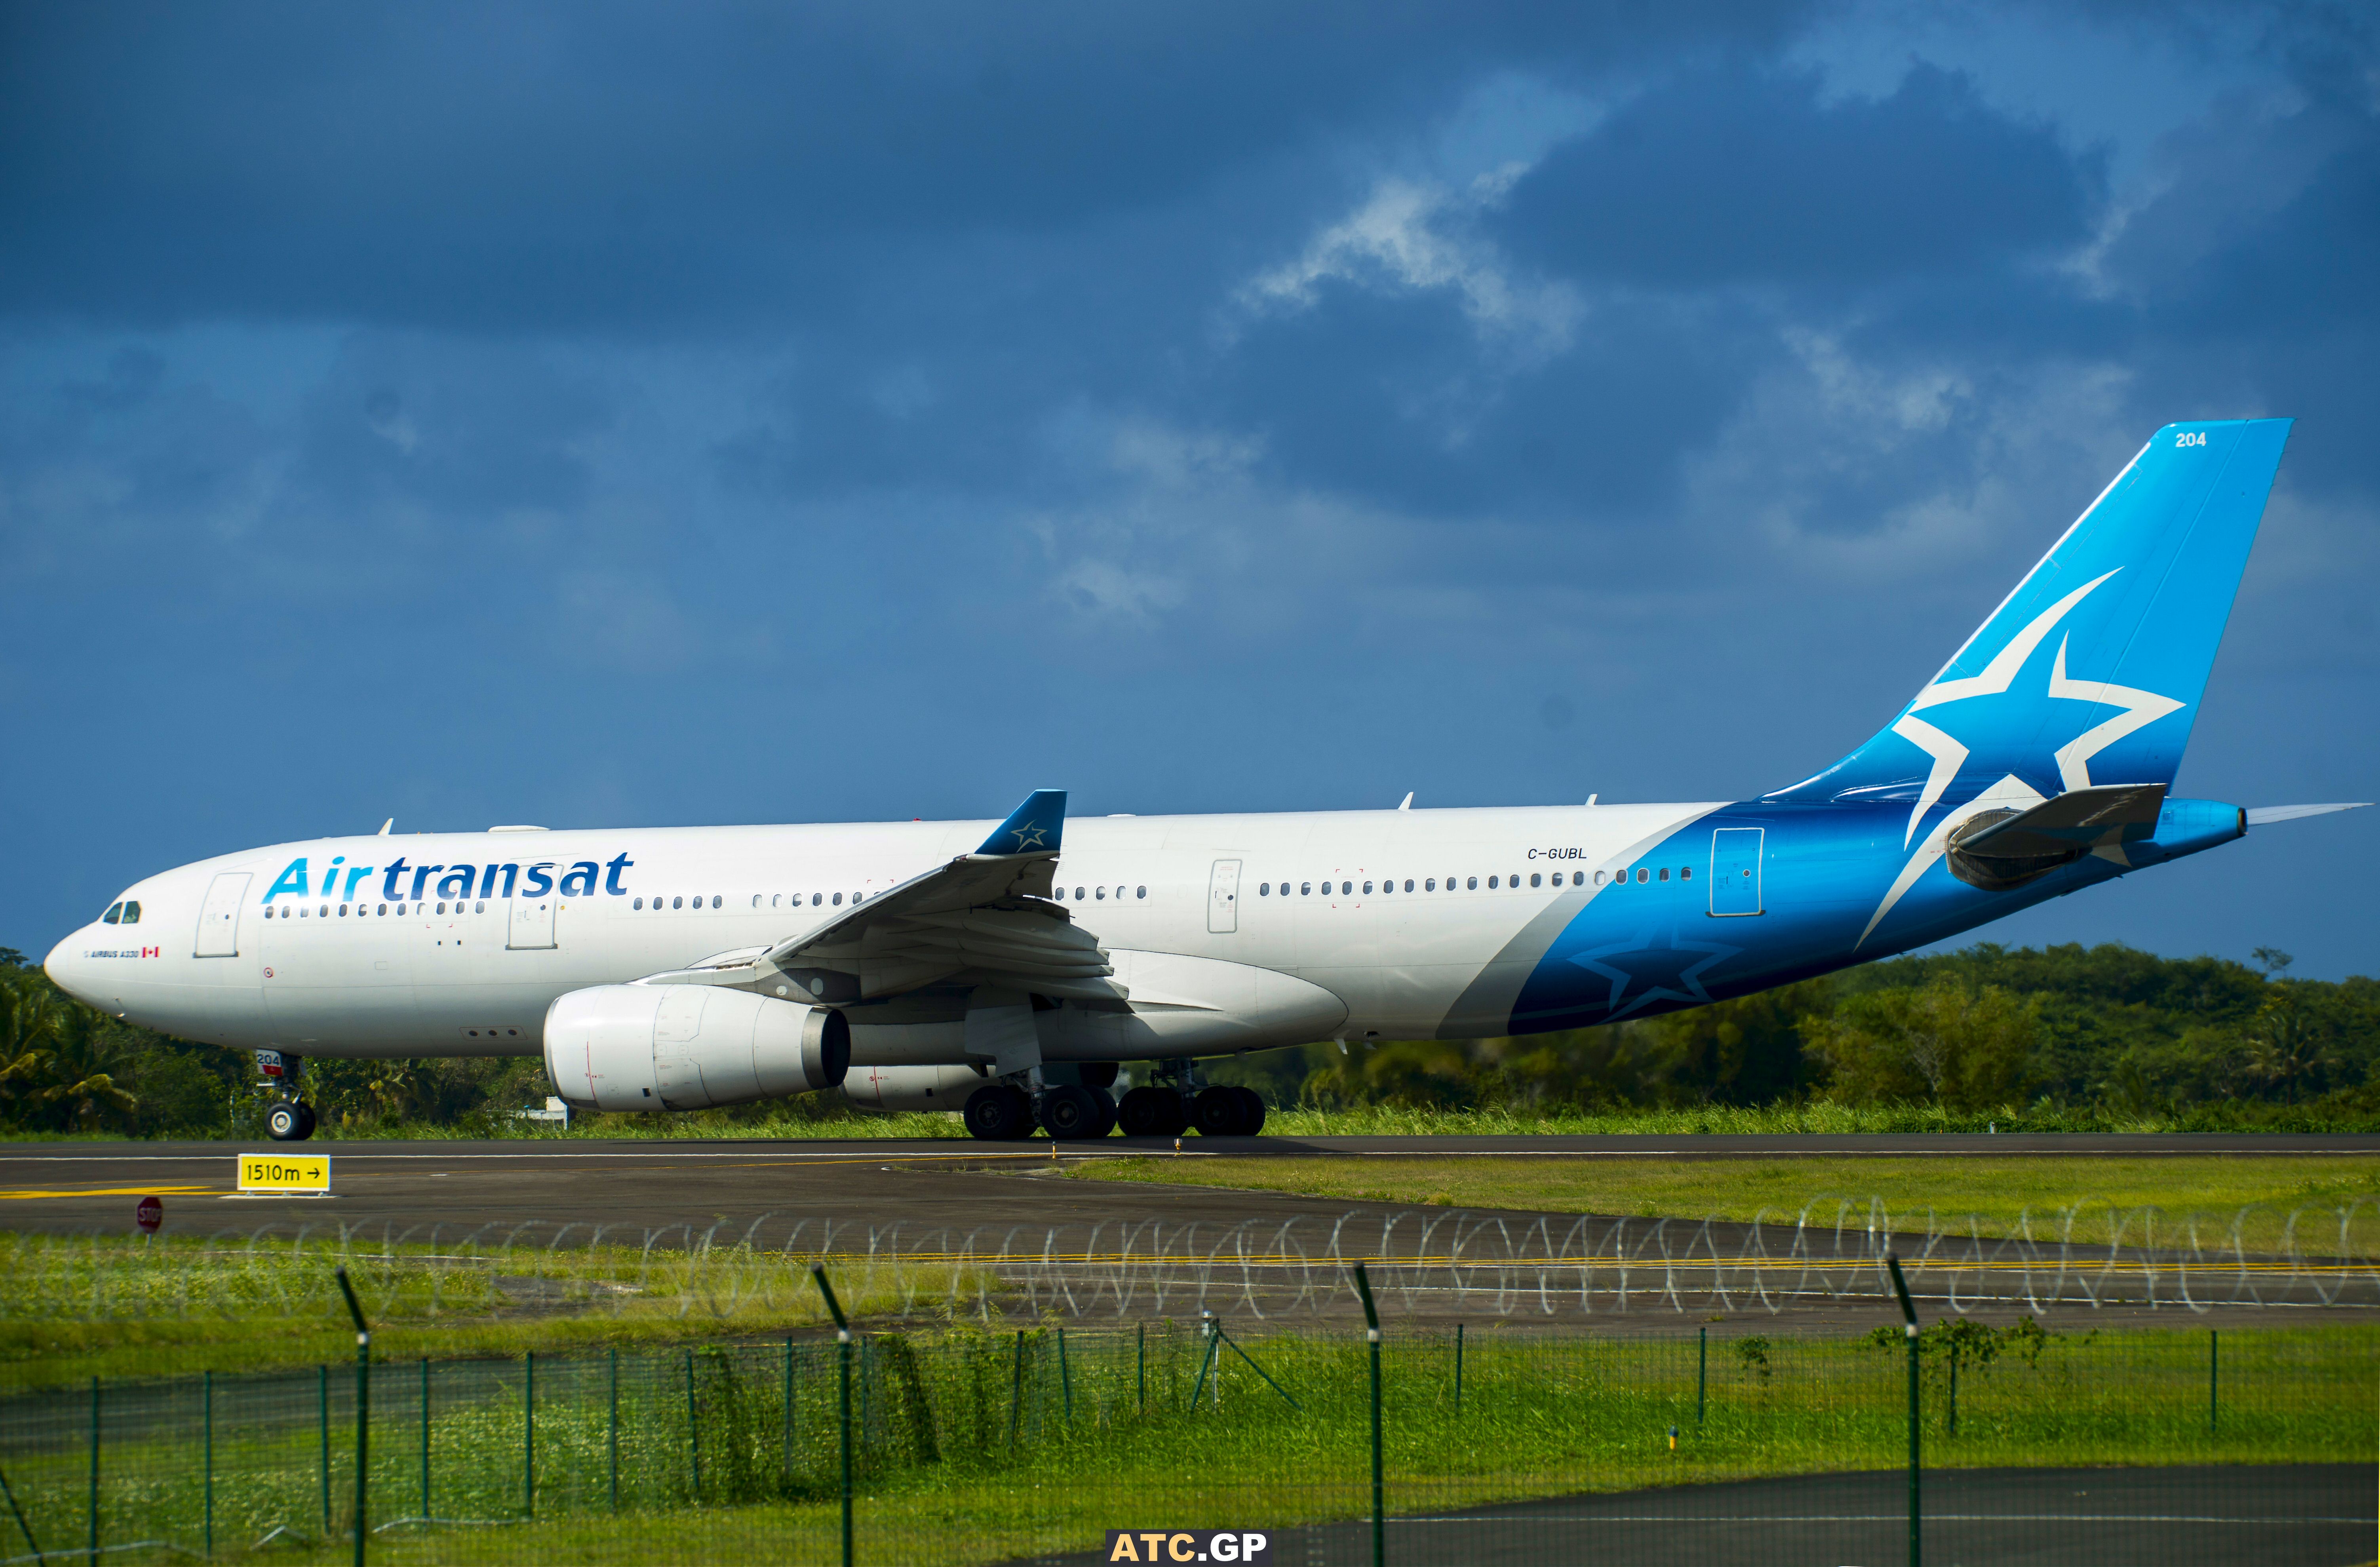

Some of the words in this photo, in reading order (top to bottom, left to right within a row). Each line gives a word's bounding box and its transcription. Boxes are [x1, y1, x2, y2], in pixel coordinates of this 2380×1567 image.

[2175, 432, 2207, 447] 204
[1528, 848, 1587, 859] C-GUBL
[257, 1054, 280, 1065] 204
[139, 1208, 162, 1222] STOP
